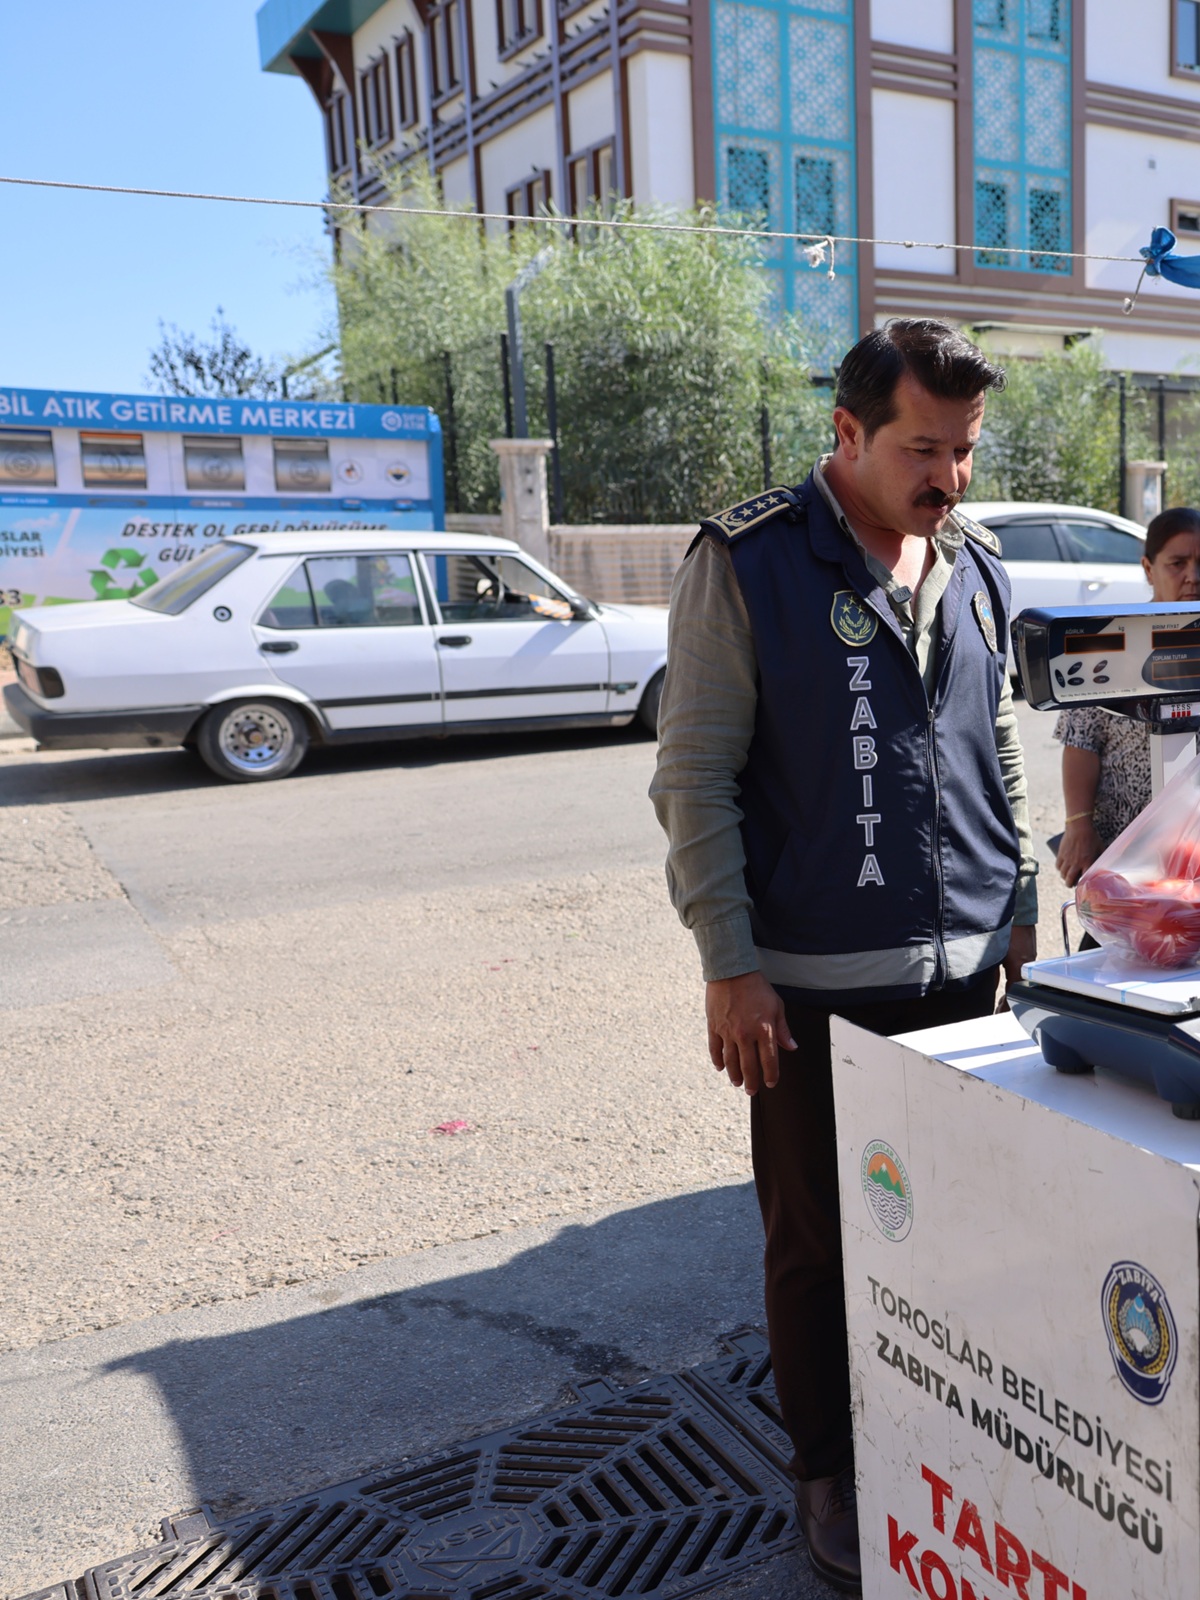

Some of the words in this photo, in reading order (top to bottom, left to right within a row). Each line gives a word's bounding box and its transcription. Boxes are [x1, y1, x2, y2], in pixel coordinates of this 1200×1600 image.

[42, 397, 103, 420] ATIK
[110, 398, 233, 426] GETİRME
[241, 406, 356, 430] MERKEZİ
[121, 523, 199, 538] DESTEK
[203, 523, 226, 538] OL
[1171, 703, 1191, 711] TESS
[847, 656, 885, 887] ZABITA
[1118, 1268, 1160, 1303] ZABITA
[867, 1275, 993, 1384] TOROSLAR
[1003, 1364, 1173, 1502] BELEDİYESİ
[876, 1331, 965, 1417] ZABITA
[971, 1396, 1164, 1556] MÜDÜRLÜĞÜ
[921, 1463, 1087, 1600] TART
